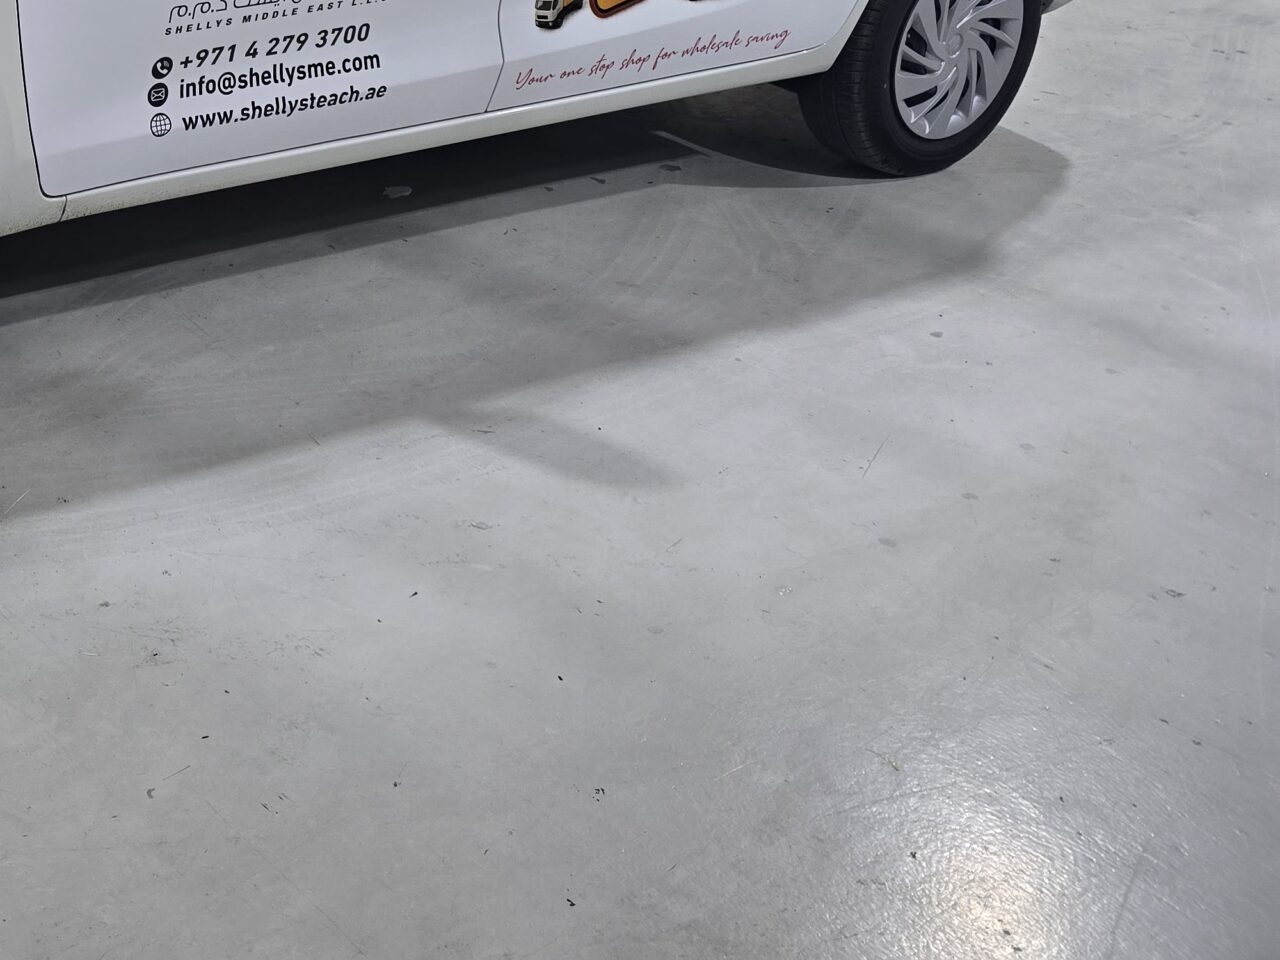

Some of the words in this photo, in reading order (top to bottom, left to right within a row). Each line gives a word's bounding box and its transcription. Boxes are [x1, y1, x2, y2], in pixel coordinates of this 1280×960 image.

[165, 17, 233, 35] SHELLYS
[242, 7, 299, 23] MIDDLE
[307, 0, 344, 13] EAST
[179, 43, 237, 69] +971
[245, 40, 259, 58] 4
[266, 32, 310, 56] 279
[315, 22, 371, 48] 3700
[515, 68, 556, 90] Your
[560, 67, 585, 79] one
[588, 54, 615, 80] stop
[619, 49, 651, 72] shop
[652, 47, 678, 70] for
[681, 30, 742, 58] wholesale
[746, 29, 791, 49] saving
[179, 53, 381, 98] info@shellysme.com
[182, 85, 388, 131] www.shellysteach.ae
